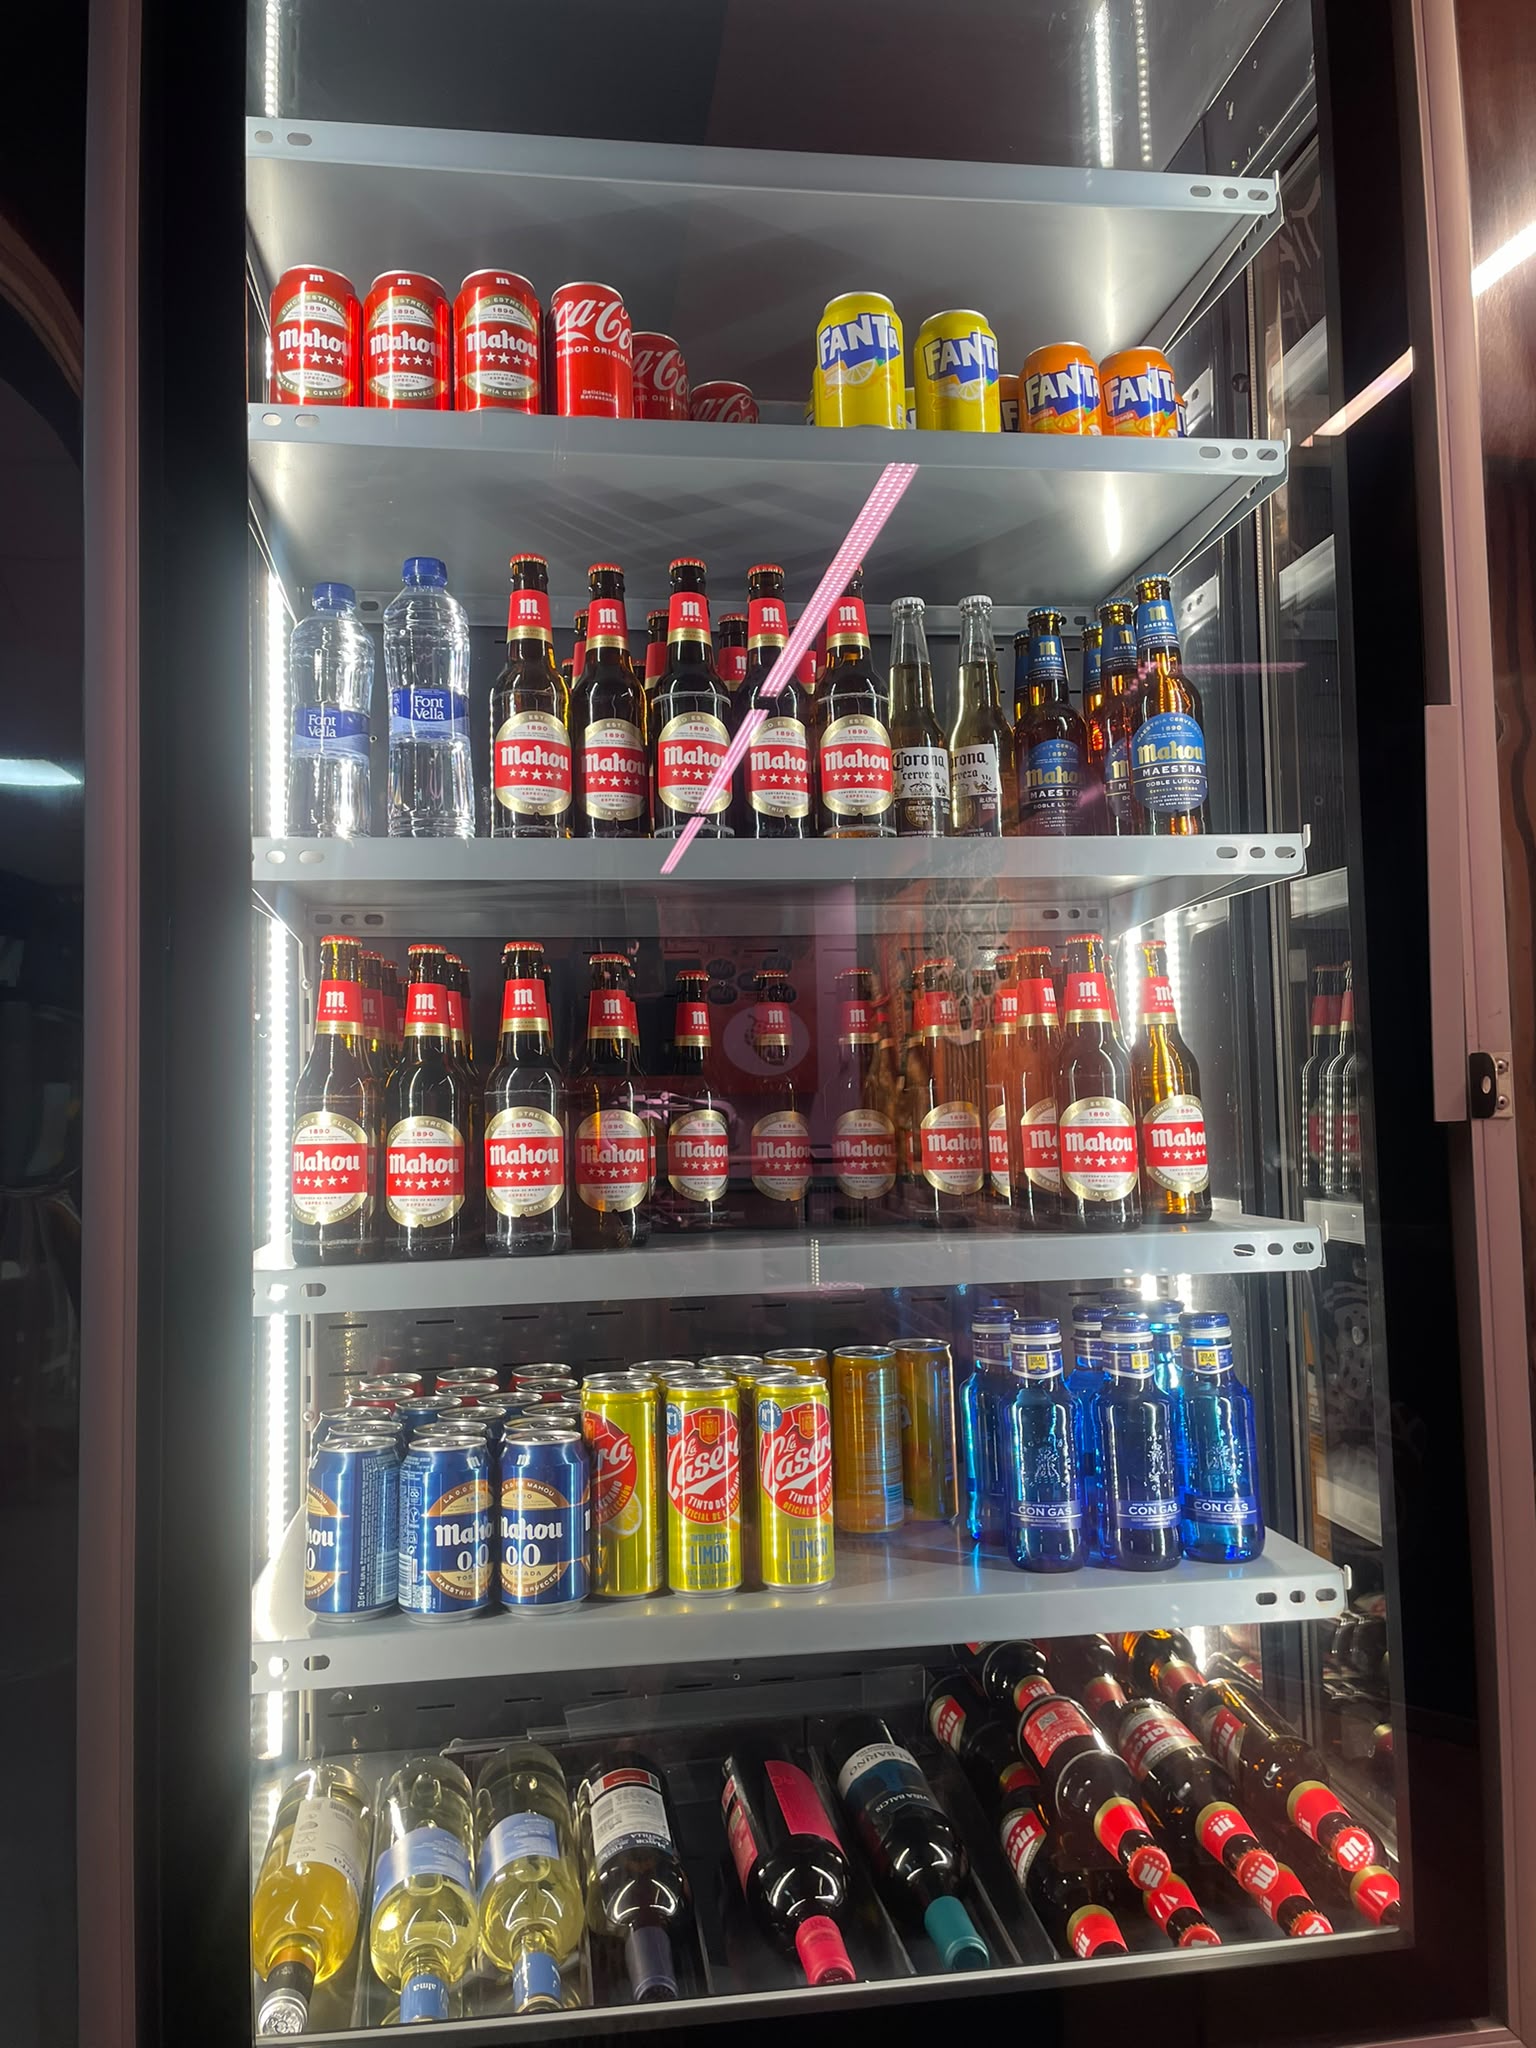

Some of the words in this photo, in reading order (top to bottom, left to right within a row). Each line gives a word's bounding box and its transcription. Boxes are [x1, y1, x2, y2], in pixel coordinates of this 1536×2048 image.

[309, 274, 324, 282] m
[496, 277, 510, 285] m
[466, 330, 538, 360] Mahou
[820, 314, 898, 366] FANTA
[1103, 368, 1174, 415] FANT
[414, 695, 443, 709] Font
[309, 714, 336, 726] Font
[414, 708, 445, 720] Vella
[308, 726, 337, 738] Vella
[689, 725, 710, 733] 1890
[501, 745, 569, 771] Mahou
[664, 745, 724, 767] Maho
[750, 750, 807, 772] Maho
[824, 748, 889, 772] Mahou
[892, 751, 945, 771] Corona
[1137, 740, 1203, 765] Mahou
[584, 752, 645, 776] Mahou
[1142, 765, 1202, 777] MAESTRA
[1025, 766, 1079, 788] Maho
[1146, 780, 1170, 788] DOBLE
[834, 1139, 892, 1158] Mahou
[1065, 1131, 1133, 1152] Mahou
[293, 1149, 360, 1172] Mahou
[490, 1143, 560, 1166] Mahou
[581, 1143, 645, 1164] Mahou
[389, 1152, 460, 1174] Mahou
[685, 1438, 697, 1456] La
[786, 1433, 796, 1449] La
[527, 1482, 555, 1497] MAHOU
[789, 1490, 813, 1506] TINTO
[688, 1495, 715, 1512] TINTO
[783, 1502, 810, 1517] OFICIAL
[1018, 1505, 1045, 1516] CON
[1047, 1506, 1072, 1517] GAS
[1128, 1504, 1159, 1516] CON
[1159, 1502, 1178, 1515] GAS
[1193, 1501, 1225, 1512] CON
[1225, 1502, 1249, 1512] GAS
[683, 1505, 710, 1522] OFICIAL
[690, 1539, 729, 1566] LIMÓN
[436, 1576, 472, 1597] MAESTRÍA
[875, 1794, 905, 1813] BALCIS
[635, 1839, 666, 1849] MAYOR
[413, 1982, 436, 1992] alma
